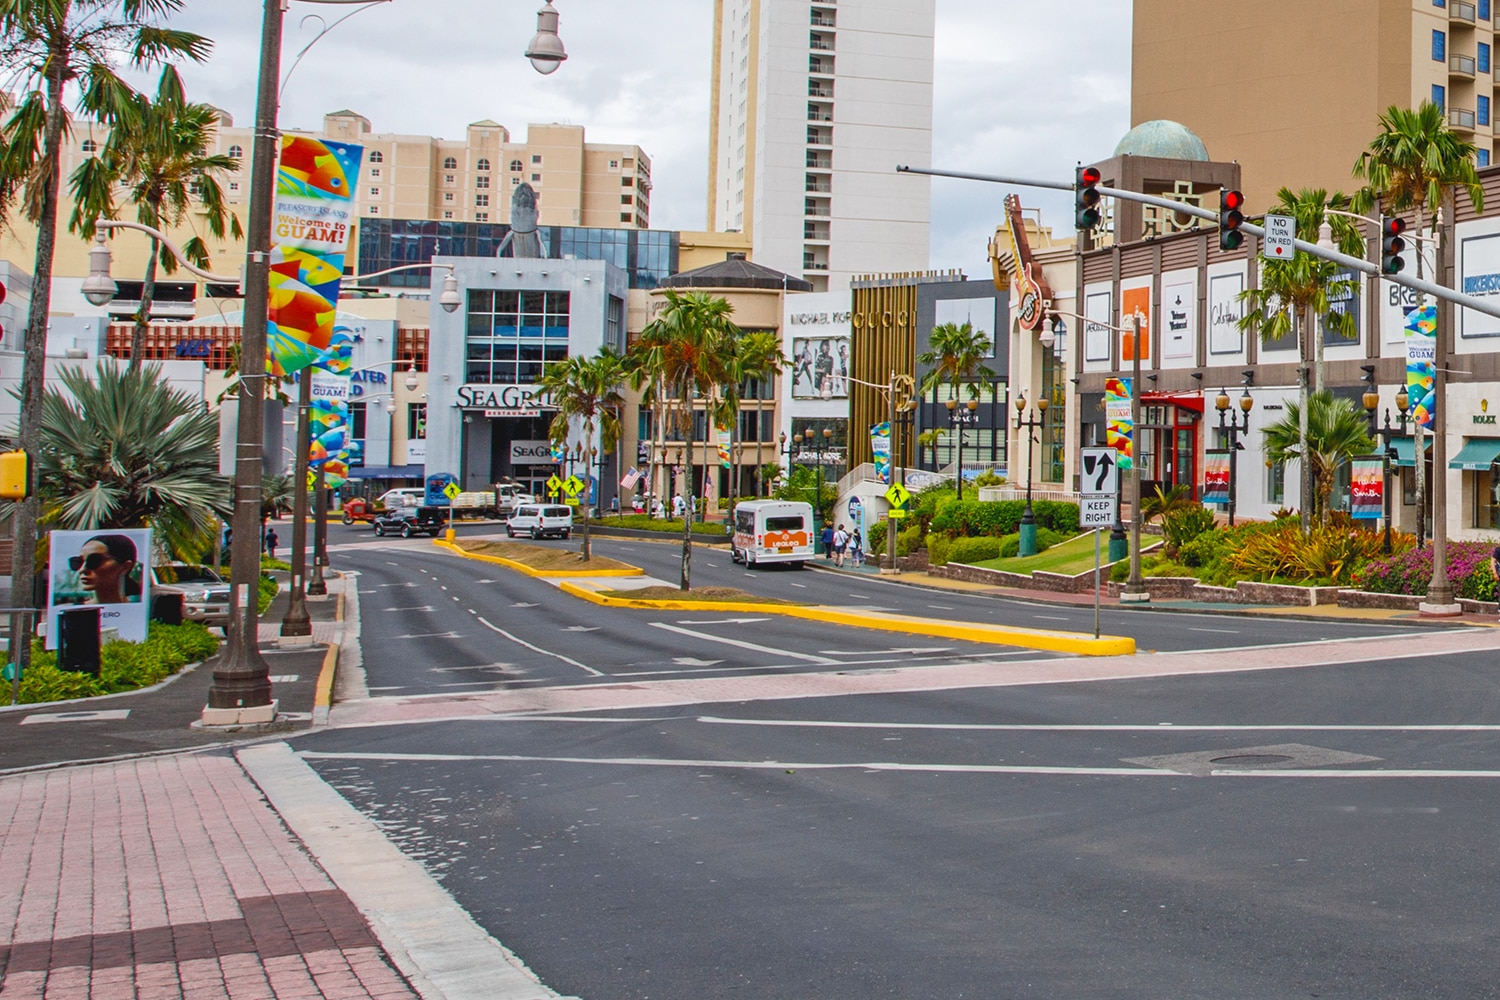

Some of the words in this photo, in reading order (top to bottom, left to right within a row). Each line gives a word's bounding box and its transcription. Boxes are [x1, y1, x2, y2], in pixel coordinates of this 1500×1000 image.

[278, 214, 331, 228] Welcome
[335, 222, 346, 230] to
[1274, 219, 1286, 227] NO
[276, 223, 344, 244] GUAM!
[791, 312, 829, 325] MICHAEL
[351, 369, 387, 384] ATER
[313, 388, 346, 397] GUAM!
[1473, 415, 1496, 424] ROLEX
[1353, 487, 1381, 497] Smith
[1087, 501, 1110, 510] KEEP
[1085, 513, 1112, 522] RIGHT
